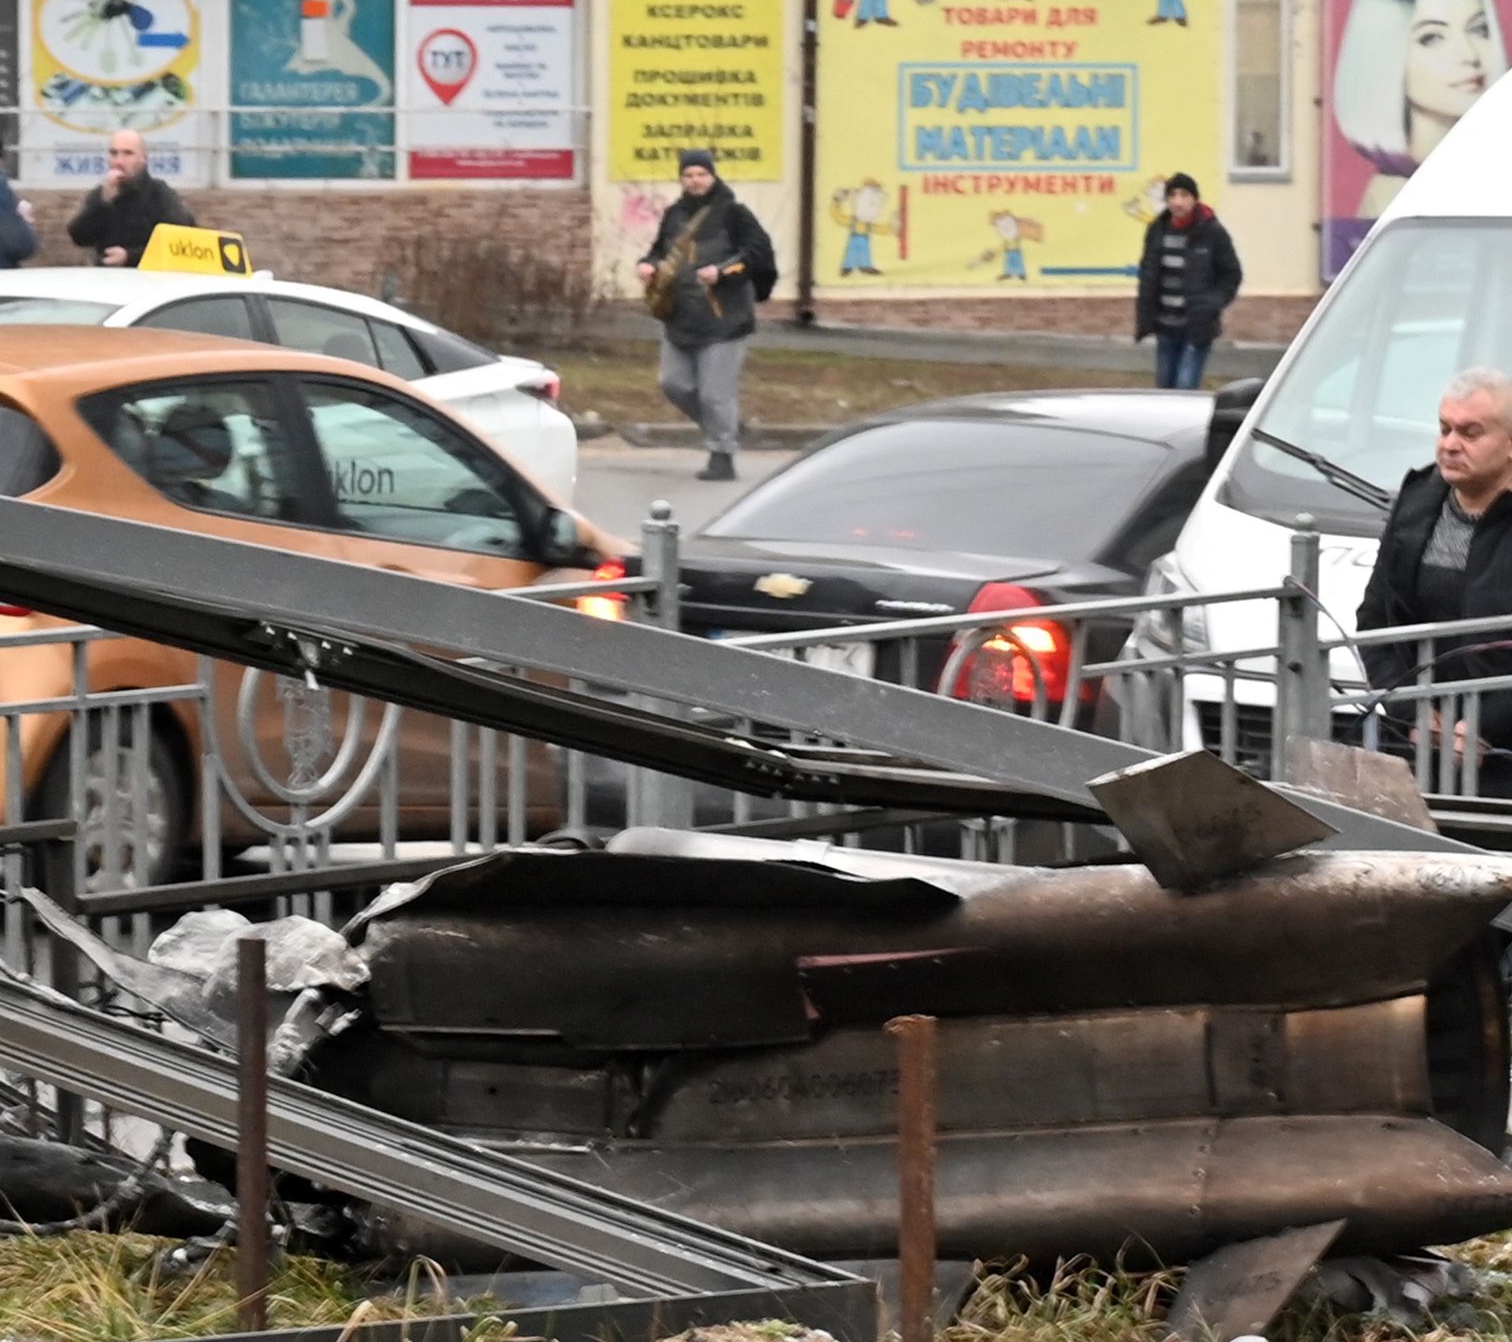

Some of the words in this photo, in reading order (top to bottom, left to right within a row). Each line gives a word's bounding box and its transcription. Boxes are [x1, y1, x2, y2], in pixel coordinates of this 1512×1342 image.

[646, 4, 746, 19] КСЕРОКС
[941, 5, 1039, 28] ТОВАРИ
[1045, 6, 1099, 29] ДЛЯ
[621, 34, 769, 52] КАНЦТОВАРИ
[959, 38, 1080, 60] РЕМОНТУ
[633, 69, 758, 85] ПРОШИВКА
[624, 92, 766, 109] ДОКУМЕНТІВ
[909, 71, 1127, 113] БУДІВЕЛЬНІ
[641, 123, 755, 138] ЗАПРАВКА
[633, 146, 762, 161] КАТДЖІВ
[915, 125, 1122, 161] МАТЕРІАЛИ
[54, 154, 182, 174] ЖИВНЯ
[921, 174, 1118, 196] ІНСТРУМЕНТИ
[168, 238, 214, 262] uklon
[327, 460, 395, 496] klon
